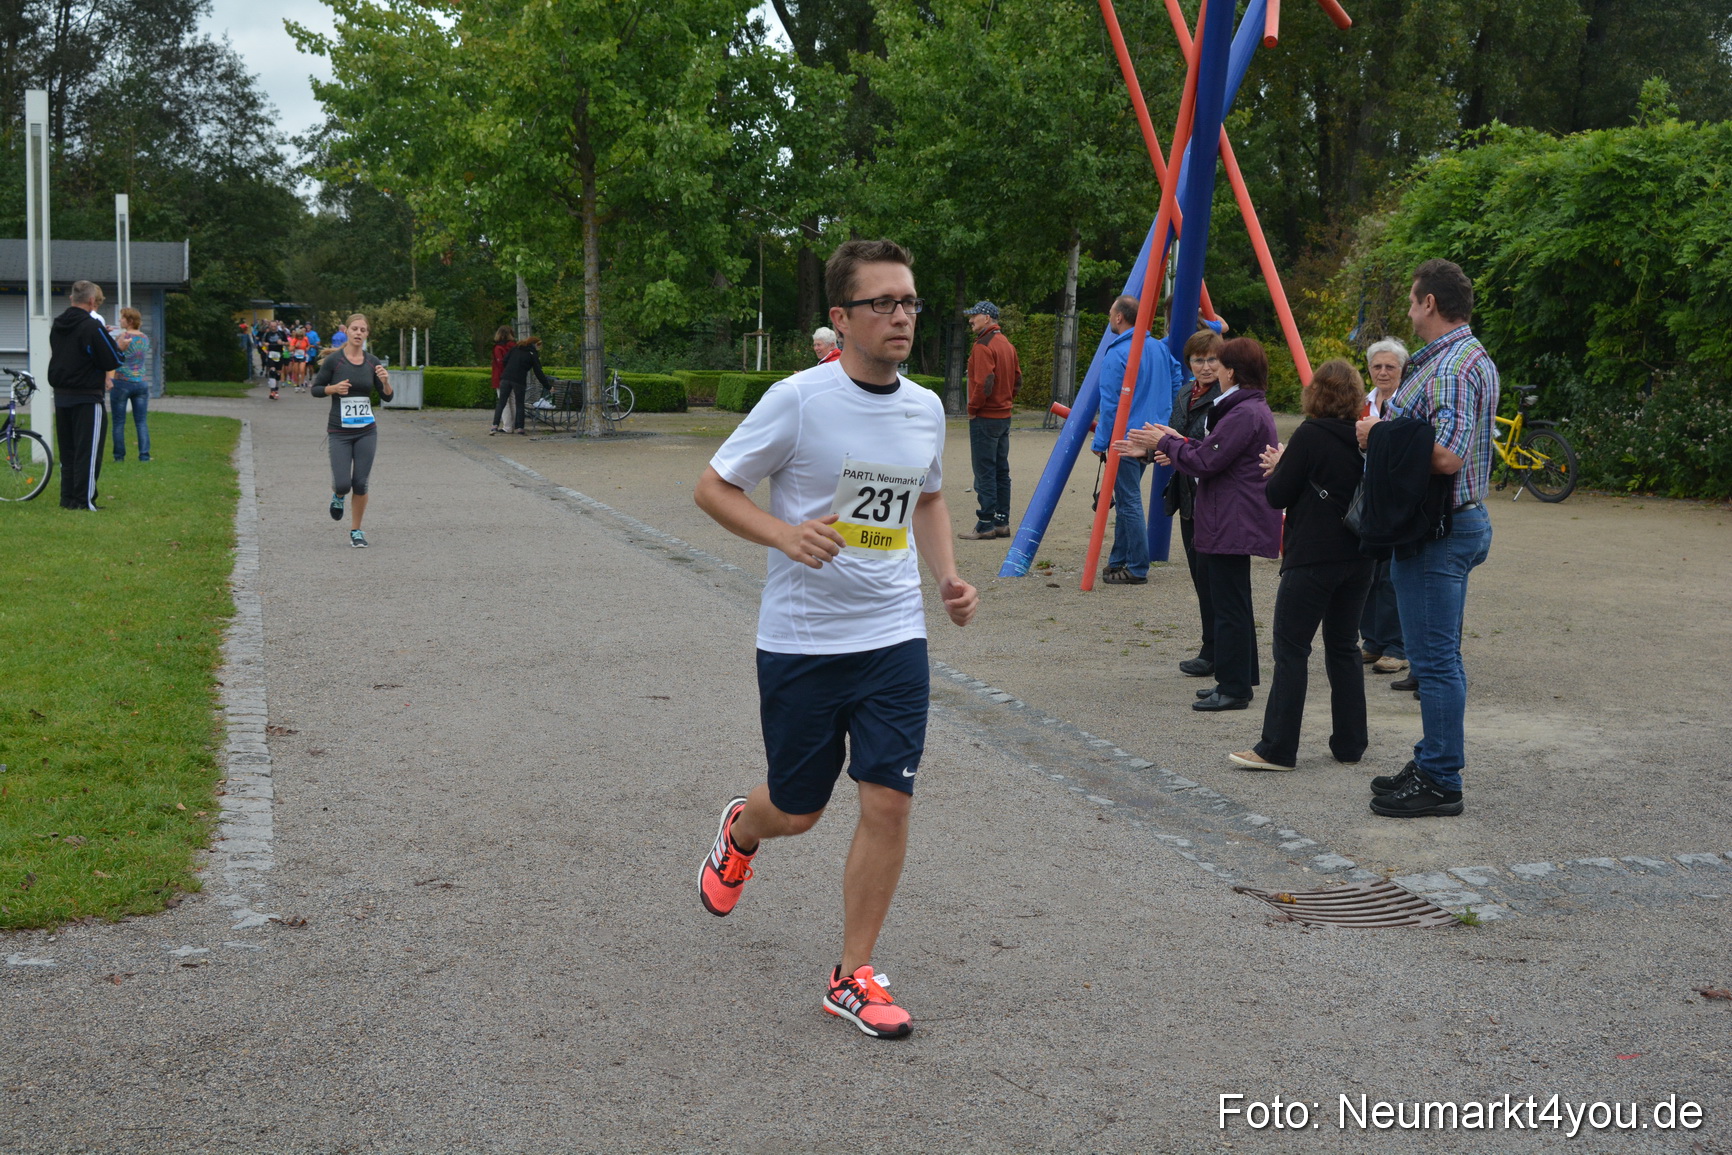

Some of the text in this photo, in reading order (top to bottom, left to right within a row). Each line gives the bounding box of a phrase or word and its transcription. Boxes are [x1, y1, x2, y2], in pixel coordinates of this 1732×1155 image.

[344, 404, 371, 417] 2122
[843, 469, 918, 486] PARTL Neumarkt
[851, 486, 911, 525] 231
[860, 530, 893, 548] Björn
